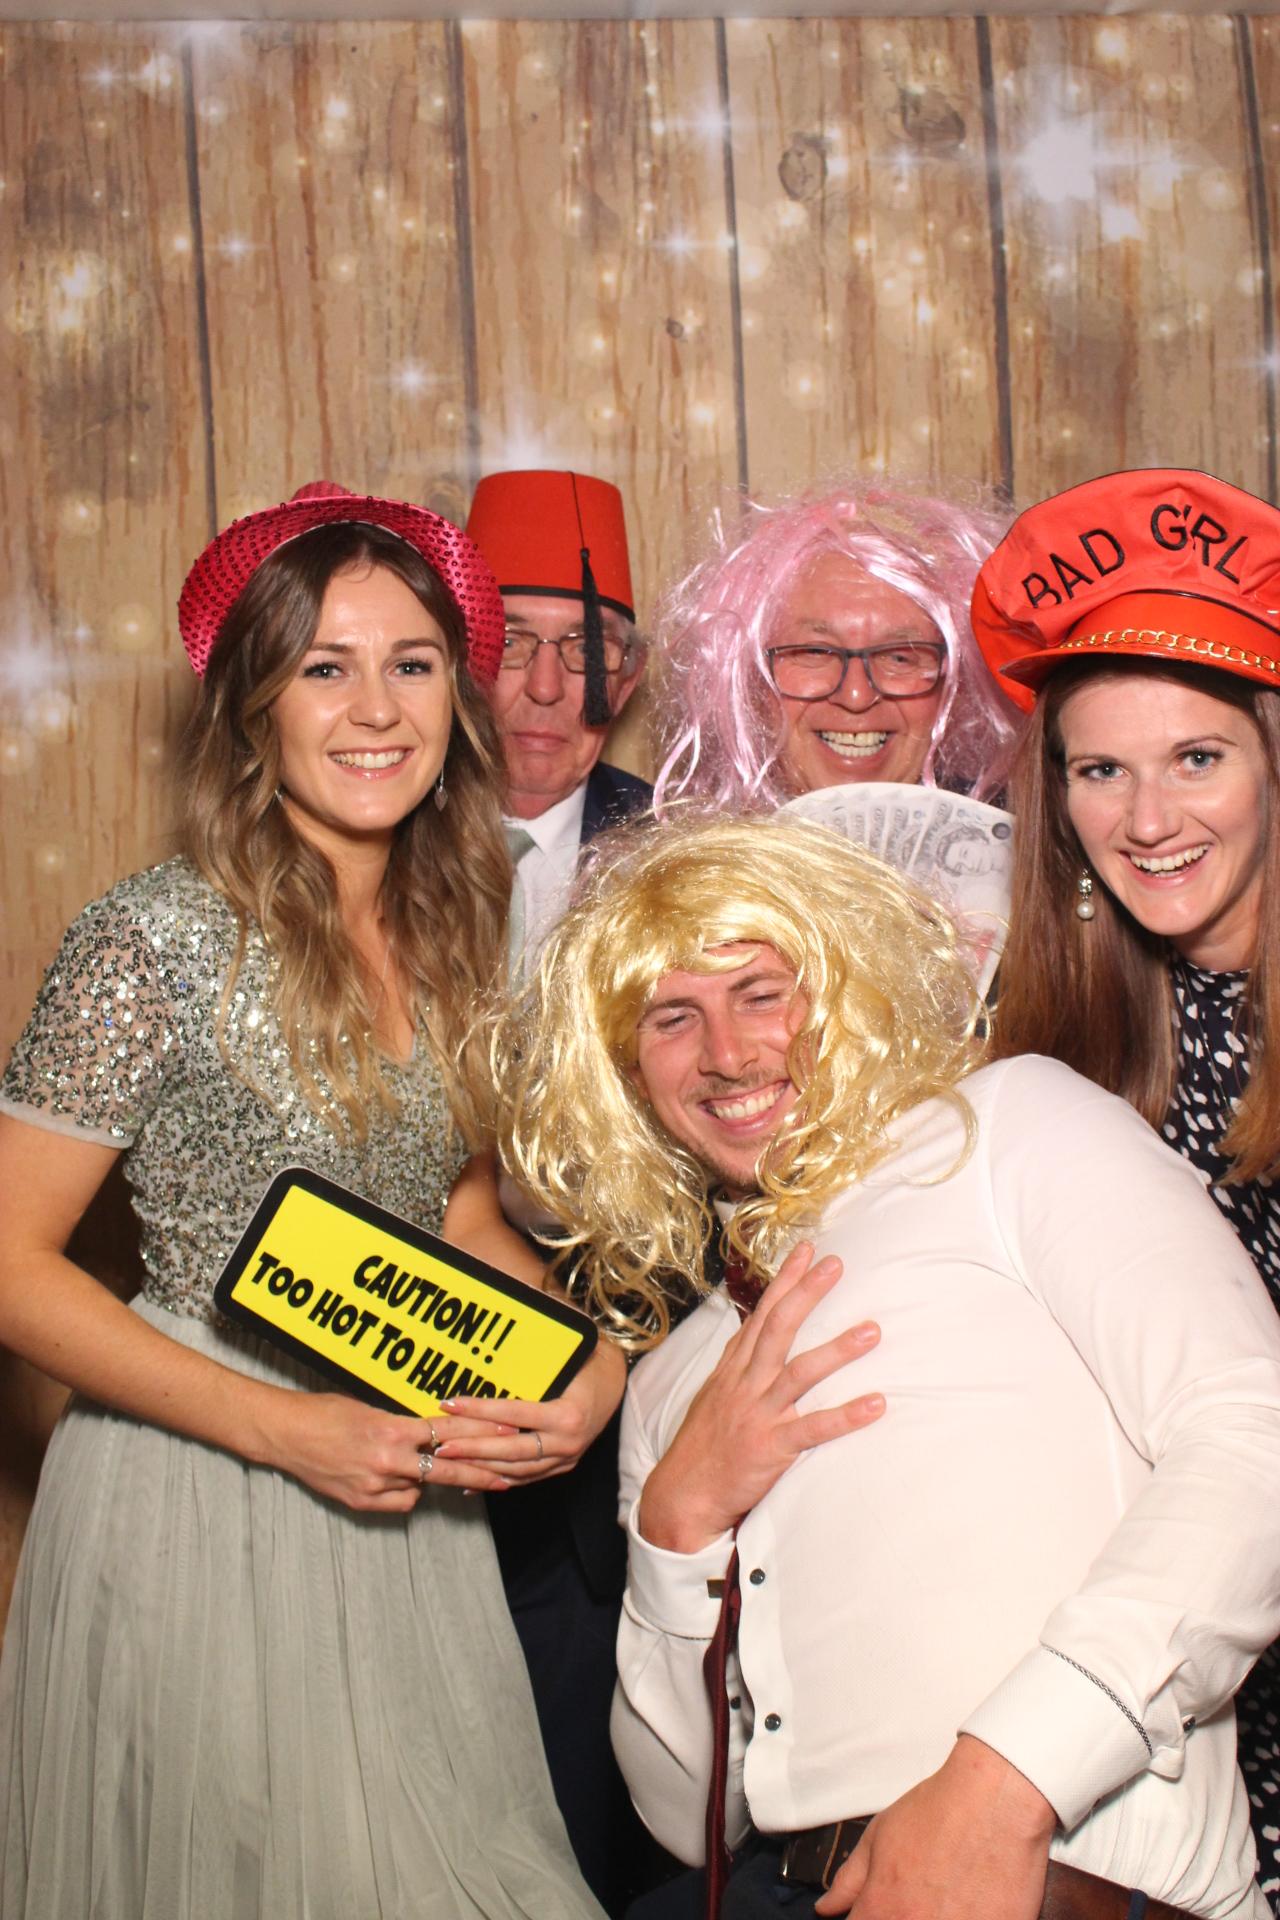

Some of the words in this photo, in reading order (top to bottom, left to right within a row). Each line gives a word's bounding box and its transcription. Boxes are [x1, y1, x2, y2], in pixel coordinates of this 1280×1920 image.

[1021, 528, 1126, 609] BAD
[251, 1251, 314, 1308] TOO
[307, 1288, 381, 1347] HOT
[371, 1322, 416, 1371] TO
[353, 1254, 517, 1364] CAUTION!!
